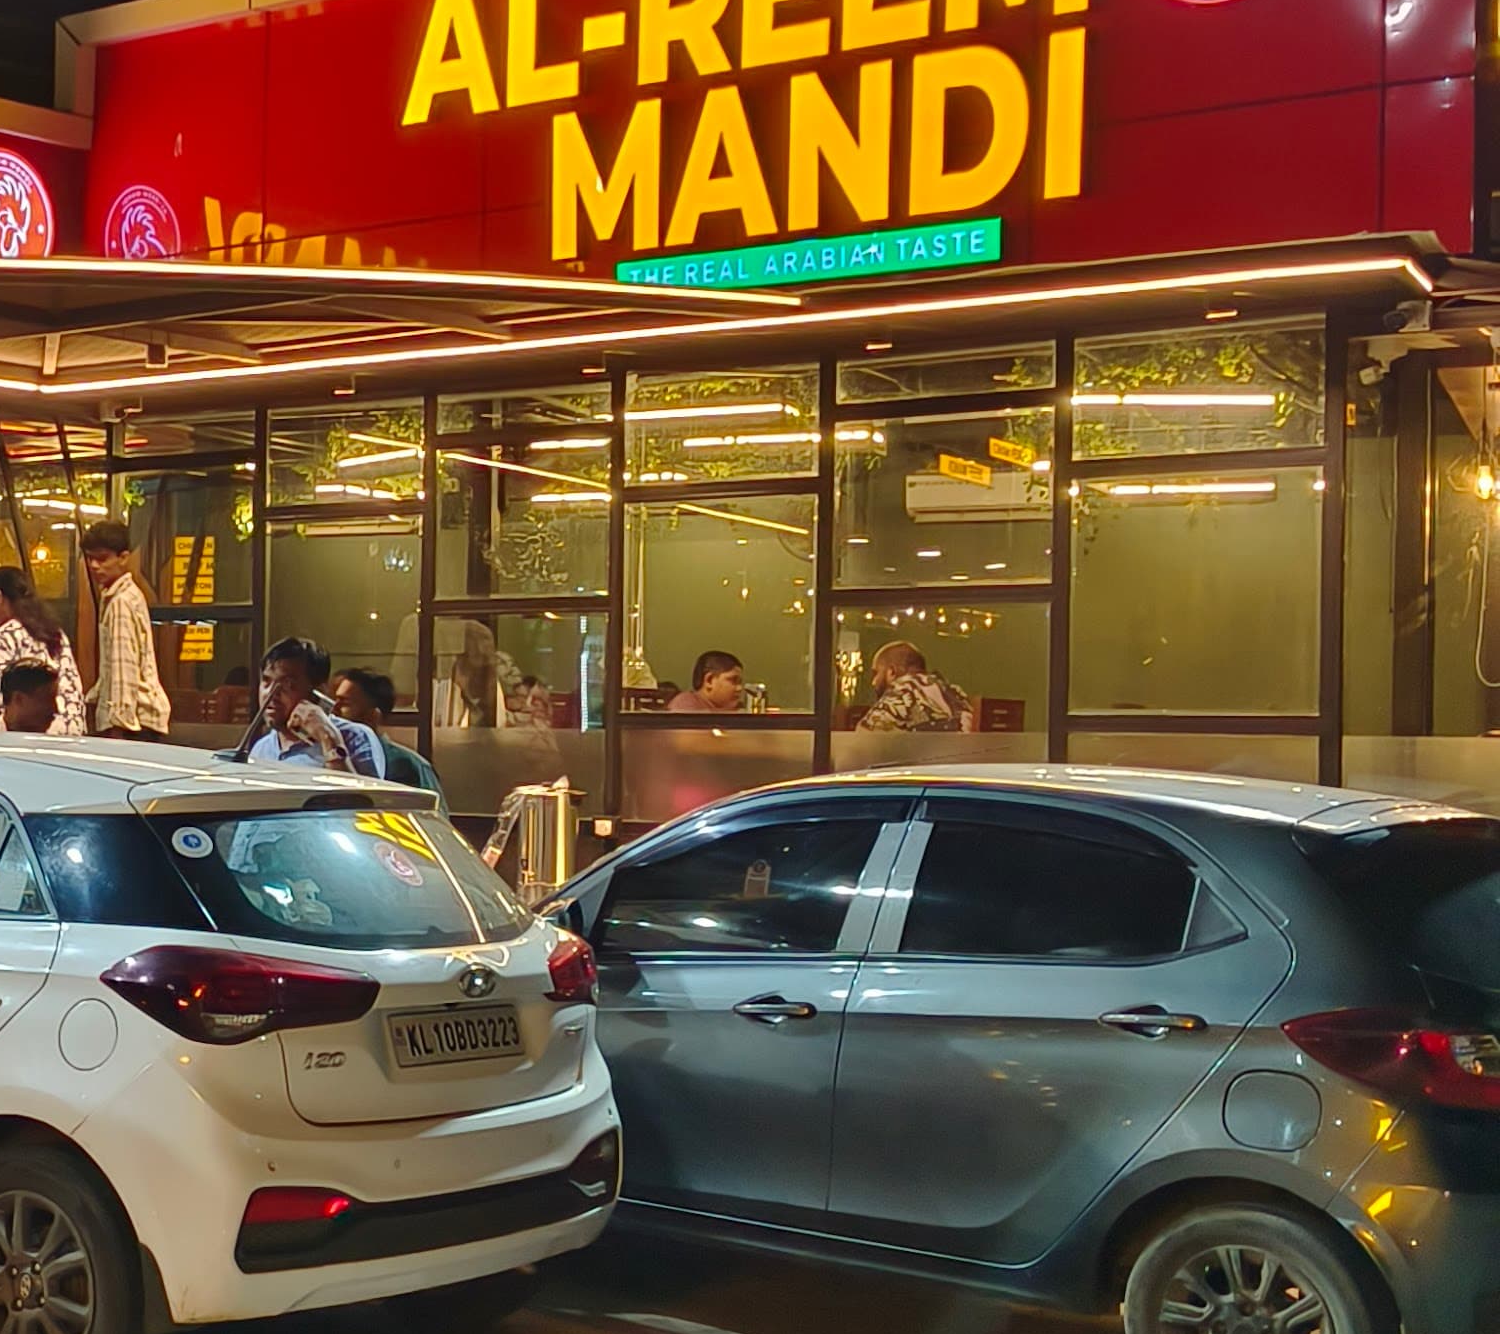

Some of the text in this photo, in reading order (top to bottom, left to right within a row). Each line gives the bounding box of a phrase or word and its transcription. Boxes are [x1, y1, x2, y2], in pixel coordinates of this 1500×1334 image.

[551, 25, 1086, 261] MANDI
[629, 228, 986, 286] THE REAL ARABIAN TASTE
